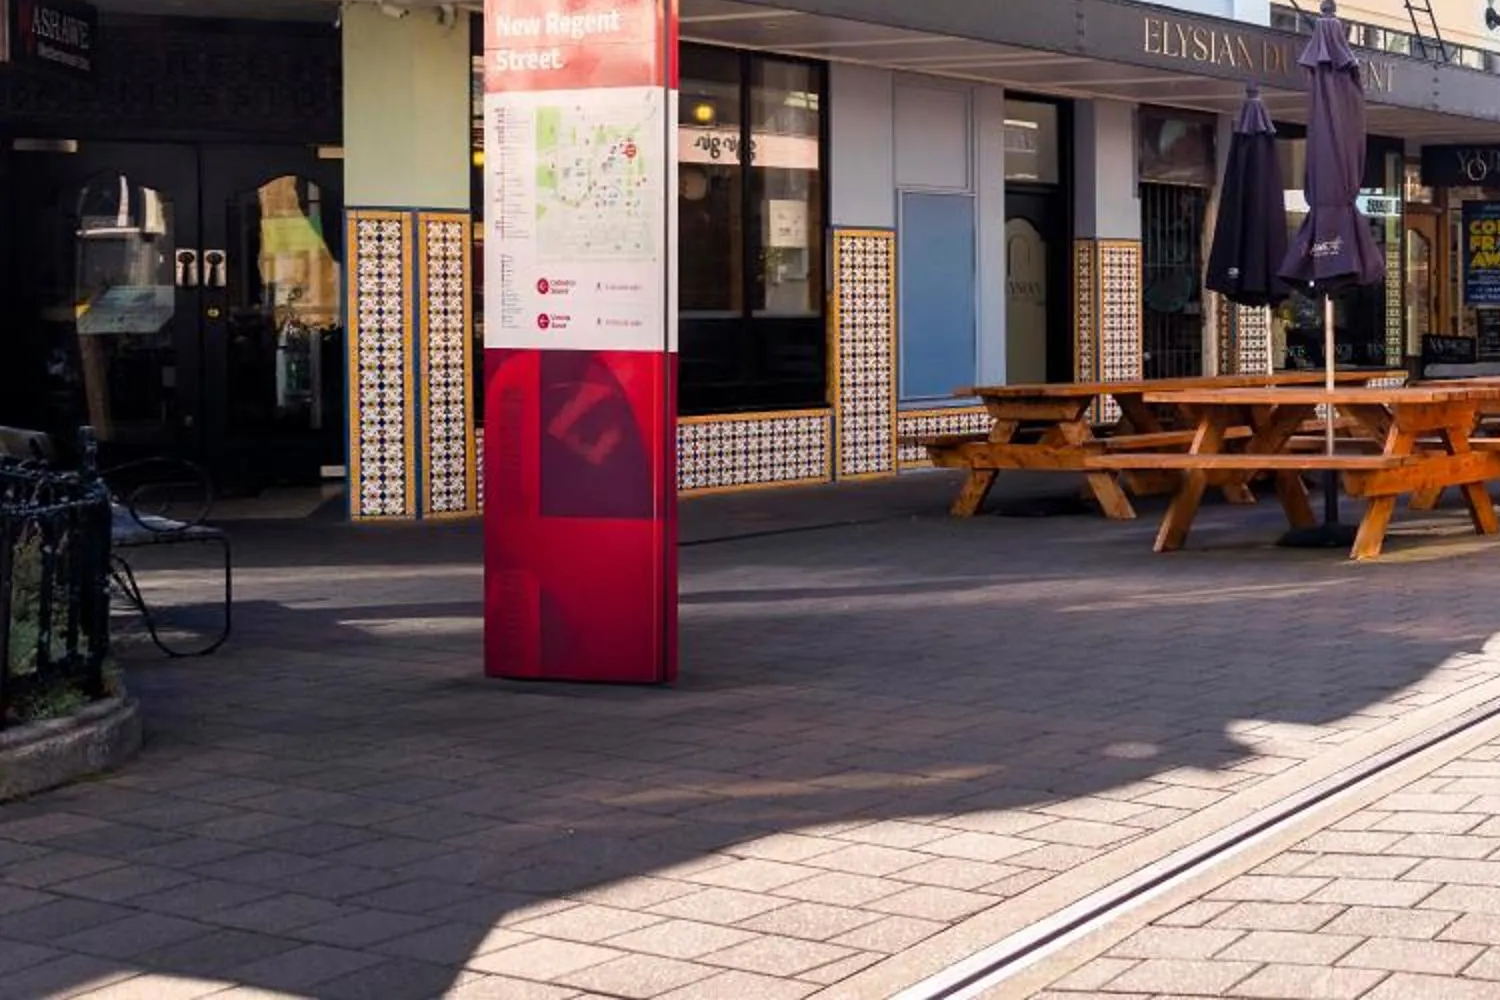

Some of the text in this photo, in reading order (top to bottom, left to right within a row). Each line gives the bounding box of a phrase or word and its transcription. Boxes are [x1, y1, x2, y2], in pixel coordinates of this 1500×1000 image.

[496, 9, 621, 39] New Regent
[1144, 17, 1253, 69] ELYSIAN
[496, 48, 564, 71] Street
